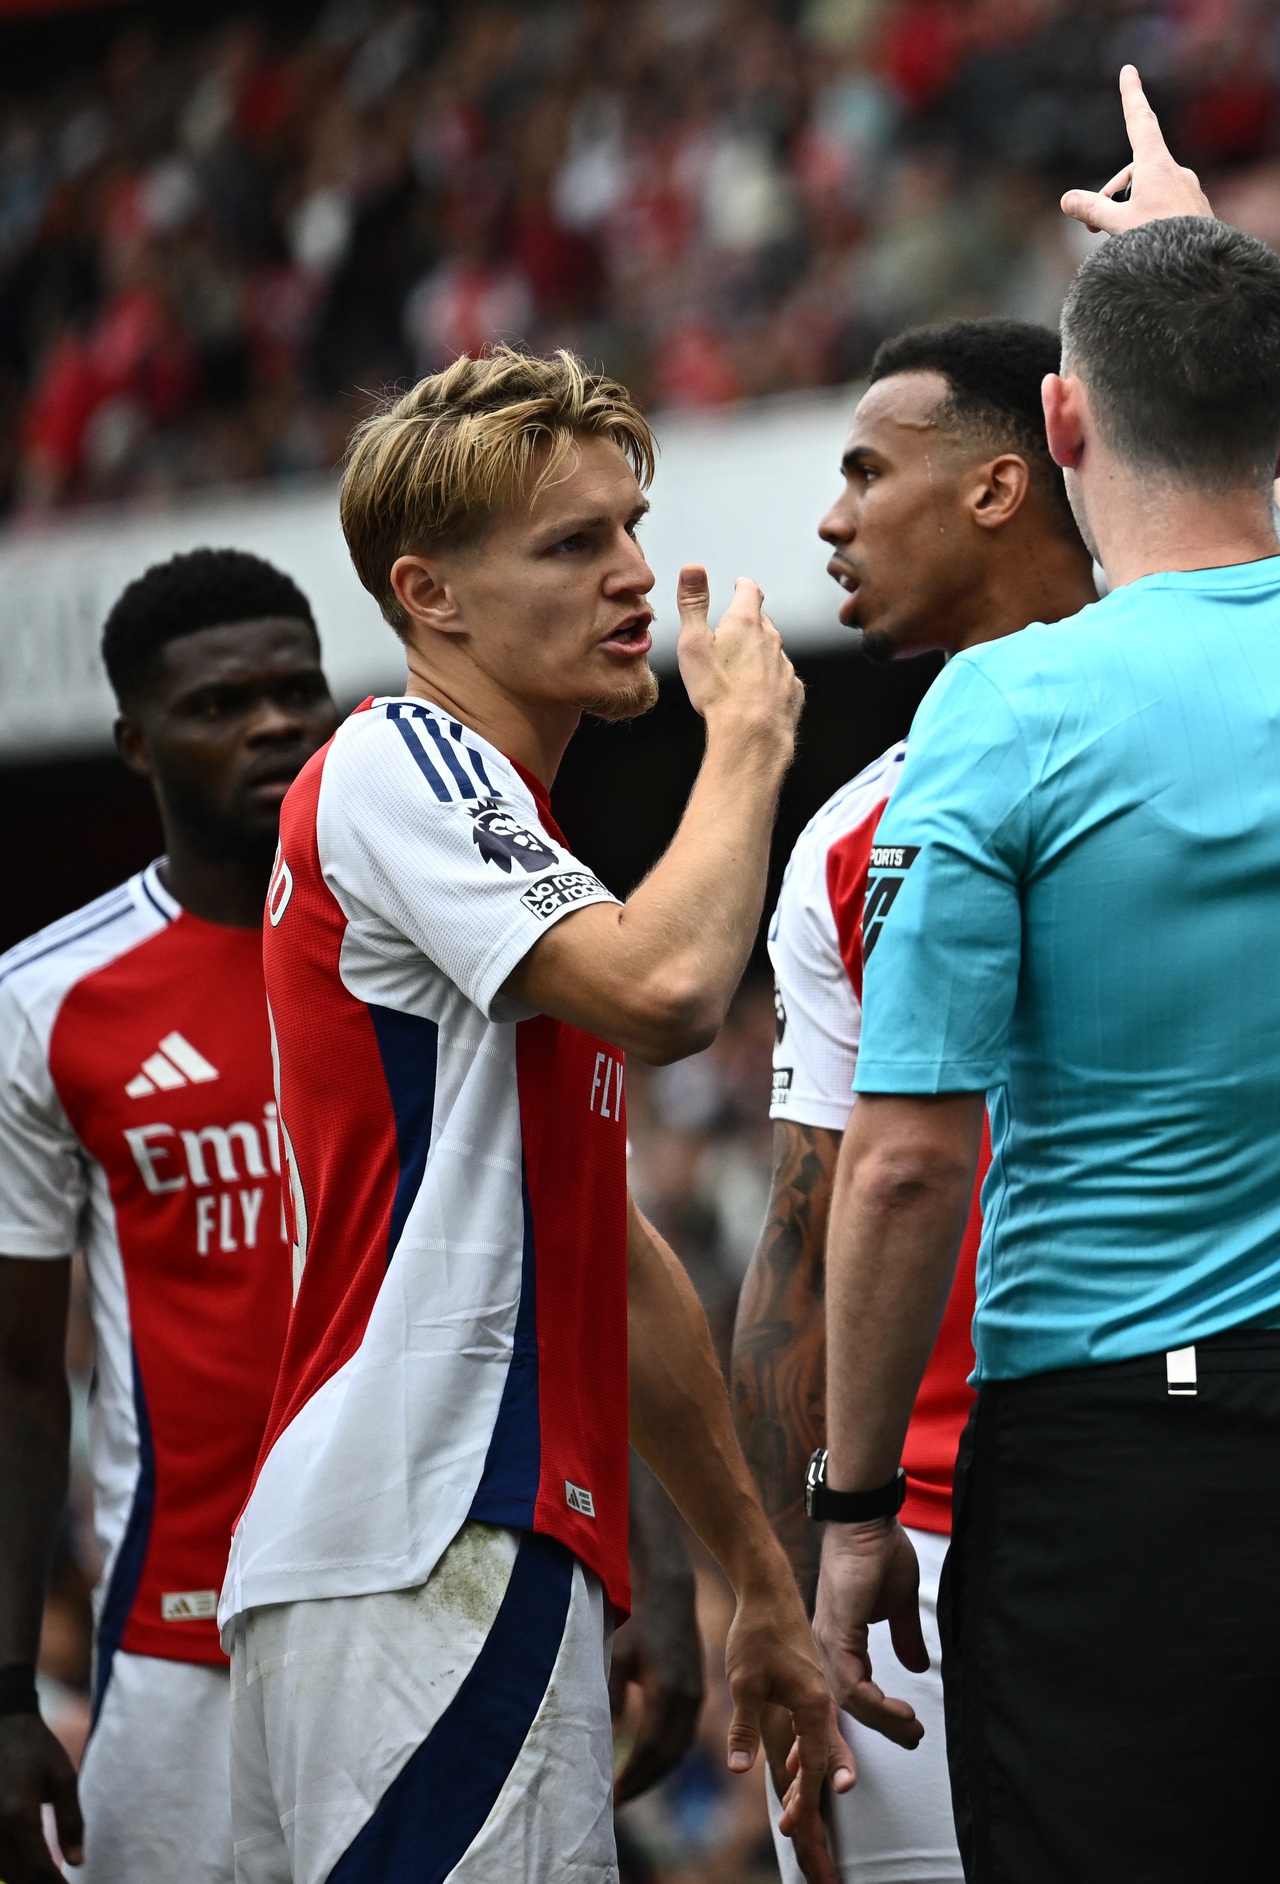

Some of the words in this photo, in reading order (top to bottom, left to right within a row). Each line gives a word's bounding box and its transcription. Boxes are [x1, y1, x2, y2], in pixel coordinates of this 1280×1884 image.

[870, 848, 905, 866] PORTS
[521, 883, 554, 910] No
[590, 1052, 623, 1122] FLY
[123, 1101, 281, 1195] Emi
[196, 1188, 263, 1257] FLY
